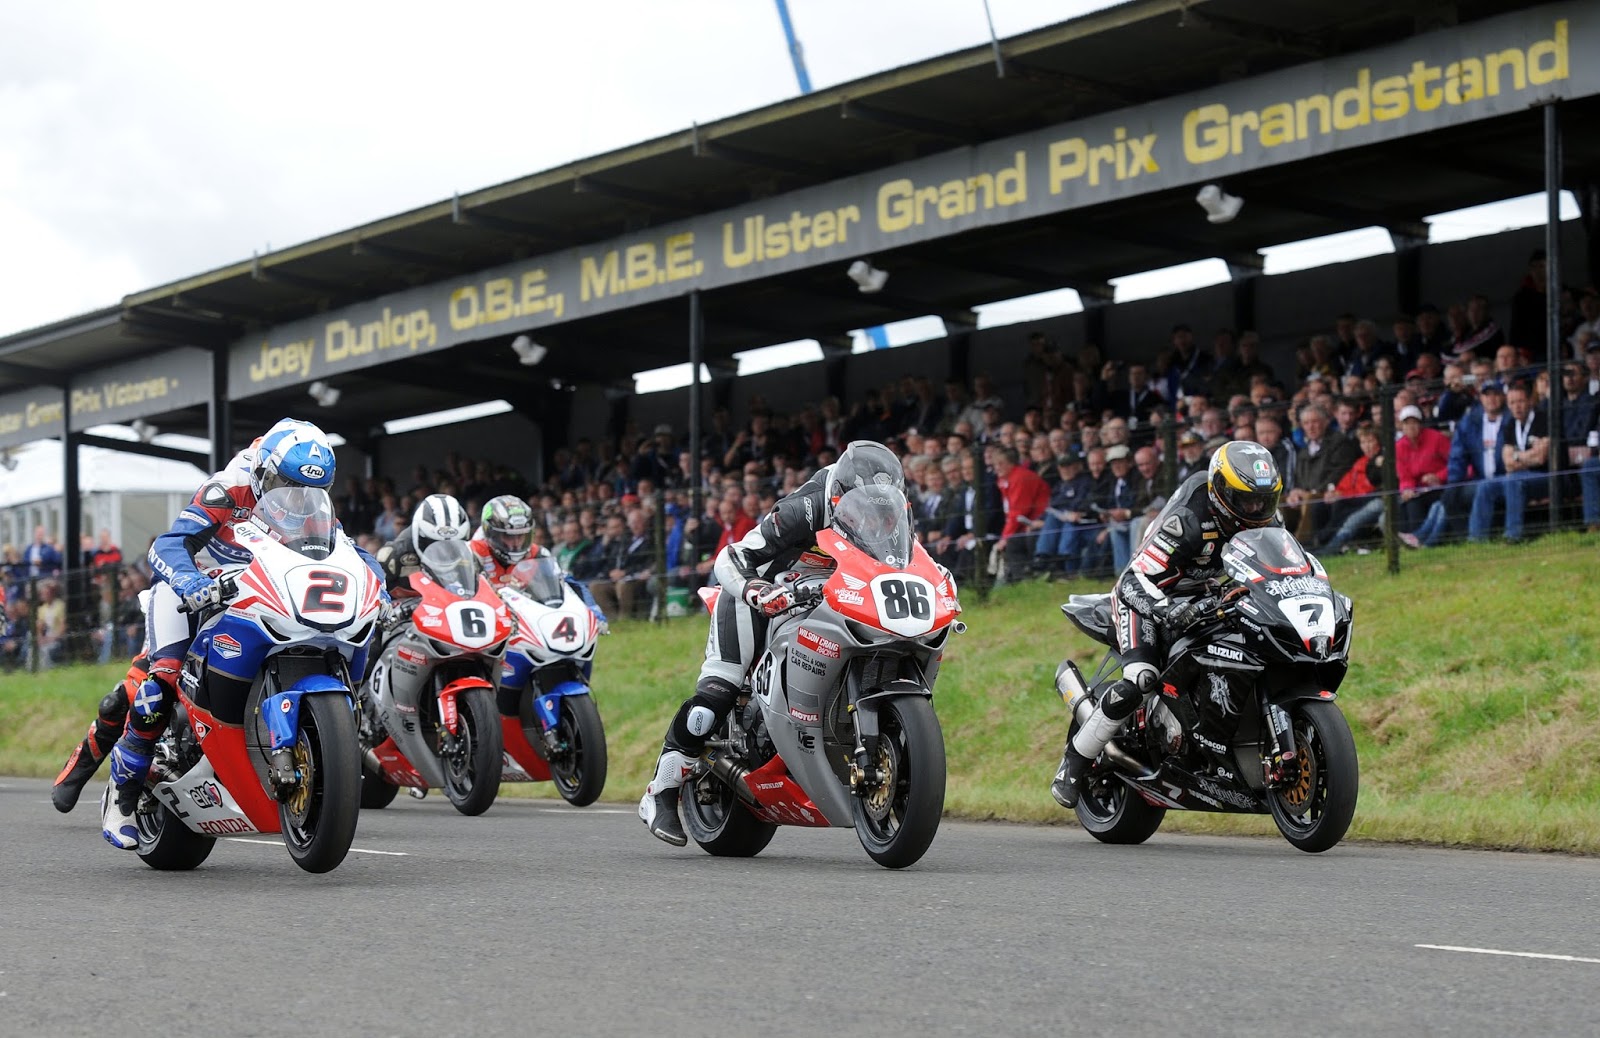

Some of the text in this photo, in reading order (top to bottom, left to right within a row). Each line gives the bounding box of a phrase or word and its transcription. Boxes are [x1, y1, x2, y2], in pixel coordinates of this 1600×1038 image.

[250, 339, 315, 382] Joey
[325, 308, 436, 362] Dunlop,
[580, 232, 704, 301] M.B.E.
[722, 205, 860, 269] Ulster
[877, 151, 1027, 232] Grand
[1049, 127, 1160, 195] Prix
[1182, 19, 1569, 165] Grandstand
[303, 466, 325, 476] Arai
[236, 525, 255, 539] elf
[301, 544, 330, 553] HONDA
[301, 570, 348, 613] 2
[834, 588, 860, 597] wilson
[838, 594, 864, 605] craig
[880, 579, 931, 620] 86
[460, 608, 486, 637] 6
[1300, 603, 1323, 627] 7
[552, 617, 578, 643] 4
[799, 628, 839, 651] WILSON CRAIG
[816, 646, 839, 658] RACING
[1207, 644, 1244, 661] SUZUKI
[756, 652, 772, 697] 86
[791, 656, 826, 677] CAR REPAIRS
[814, 659, 827, 669] SONS
[372, 665, 383, 694] 6
[791, 709, 818, 721] MOTUL
[160, 786, 190, 819] 2
[189, 784, 214, 809] elf
[197, 817, 254, 835] HONDA
